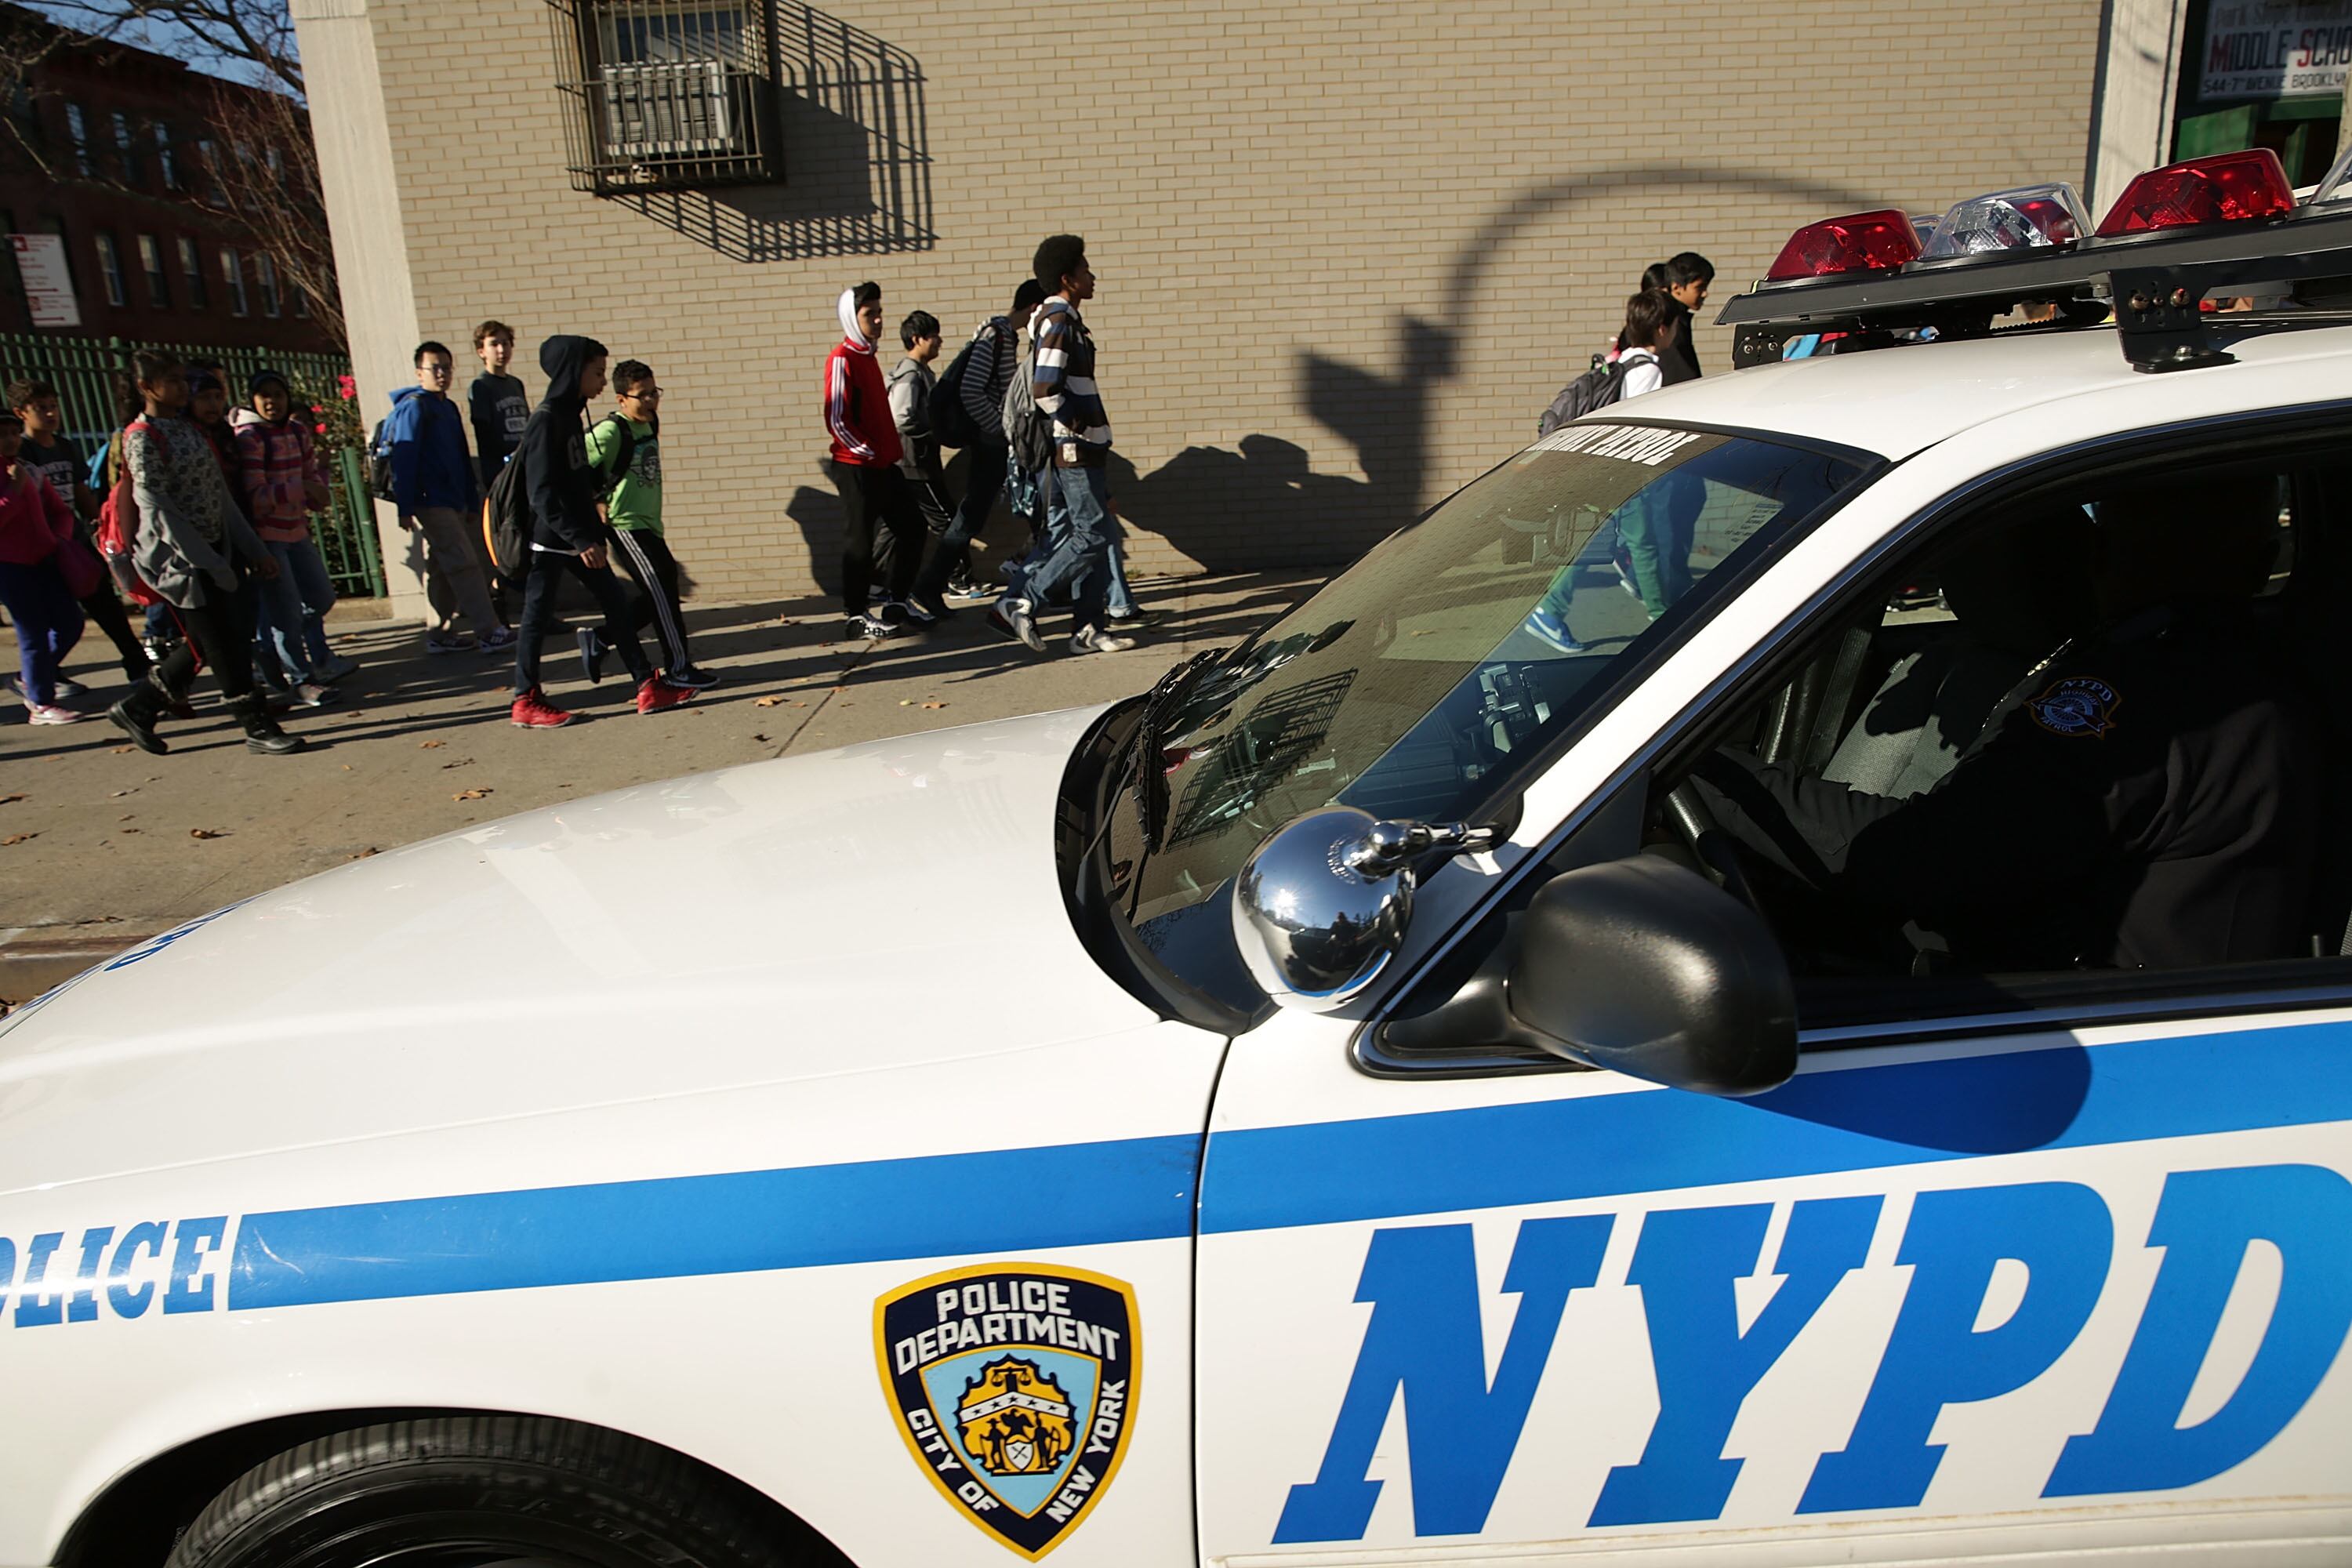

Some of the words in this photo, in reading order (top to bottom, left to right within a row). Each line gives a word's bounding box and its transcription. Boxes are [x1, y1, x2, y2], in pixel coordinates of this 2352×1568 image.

[2209, 30, 2292, 72] MIDDLE
[1582, 426, 1701, 466] PATROL
[2060, 680, 2113, 702] NYPD
[2060, 689, 2100, 706] HIGHWAY
[2038, 716, 2076, 733] PATROL
[935, 1279, 1072, 1323] POLICE
[895, 1312, 1120, 1375] DEPARTMENT
[1270, 1163, 2352, 1544] NYPD
[907, 1408, 962, 1472] CITY
[957, 1479, 1000, 1512] OF
[1045, 1465, 1097, 1523] NEW
[1085, 1379, 1126, 1454] YORK
